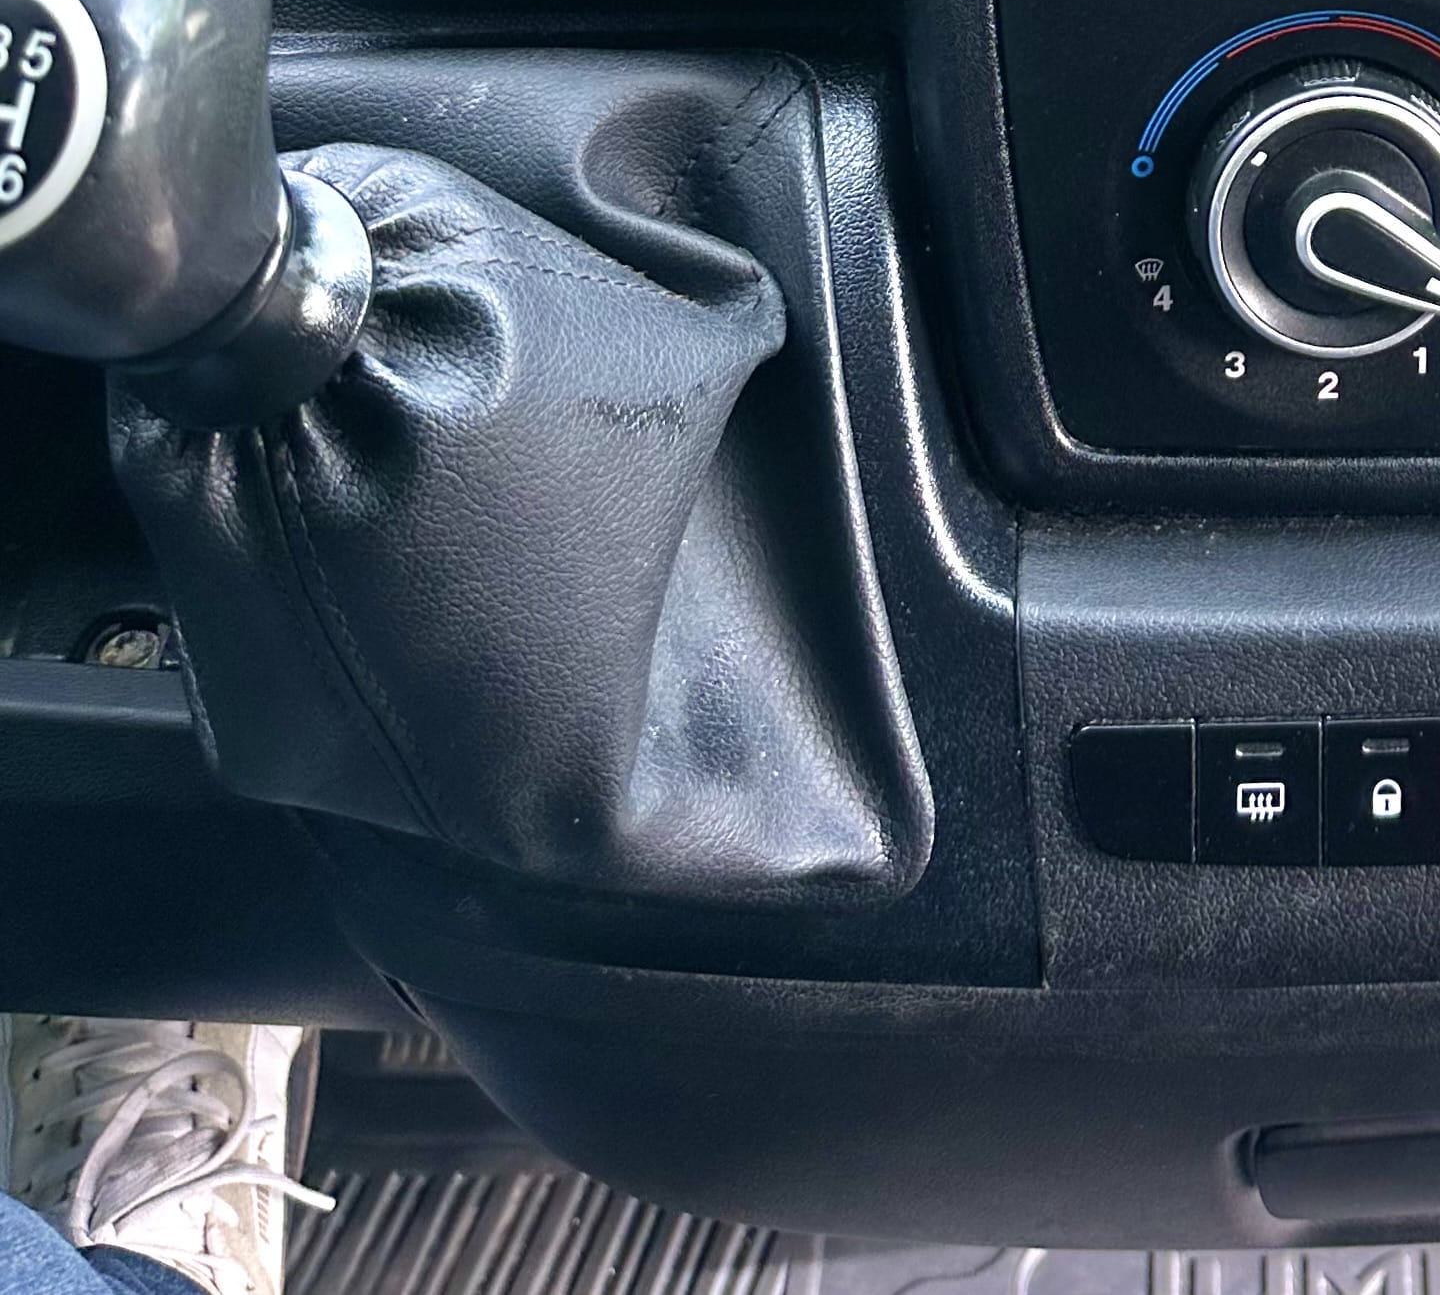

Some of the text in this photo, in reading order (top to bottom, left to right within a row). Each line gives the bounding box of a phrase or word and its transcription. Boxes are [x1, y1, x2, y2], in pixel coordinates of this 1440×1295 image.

[21, 29, 57, 78] 5
[0, 154, 28, 203] 6
[1153, 285, 1173, 312] 4
[1225, 351, 1245, 378] 3
[1413, 347, 1427, 374] 1
[1318, 372, 1339, 400] 2
